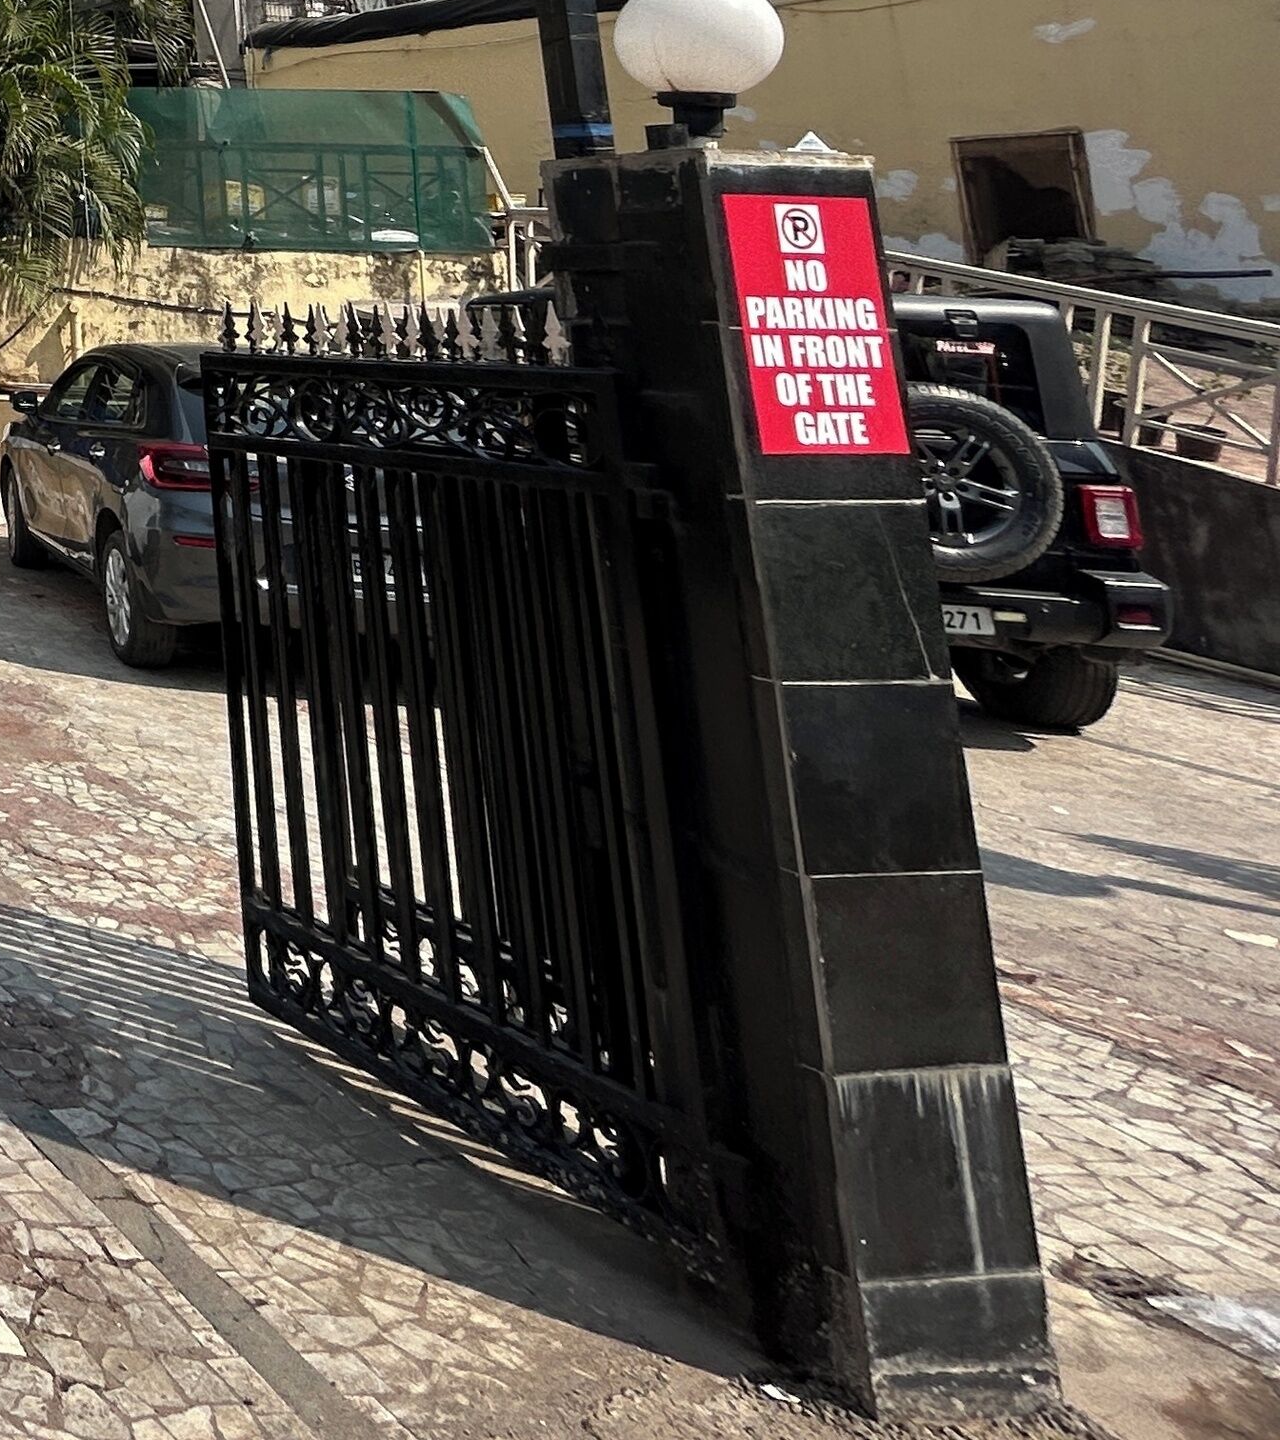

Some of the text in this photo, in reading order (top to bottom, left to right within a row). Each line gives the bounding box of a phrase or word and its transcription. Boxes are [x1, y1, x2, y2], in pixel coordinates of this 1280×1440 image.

[783, 259, 828, 292] NO
[745, 296, 879, 331] PARKING
[750, 334, 884, 369] IN FRONT
[774, 372, 813, 407] OF
[814, 373, 876, 407] THE
[794, 411, 870, 446] GATE
[944, 610, 981, 630] 271
